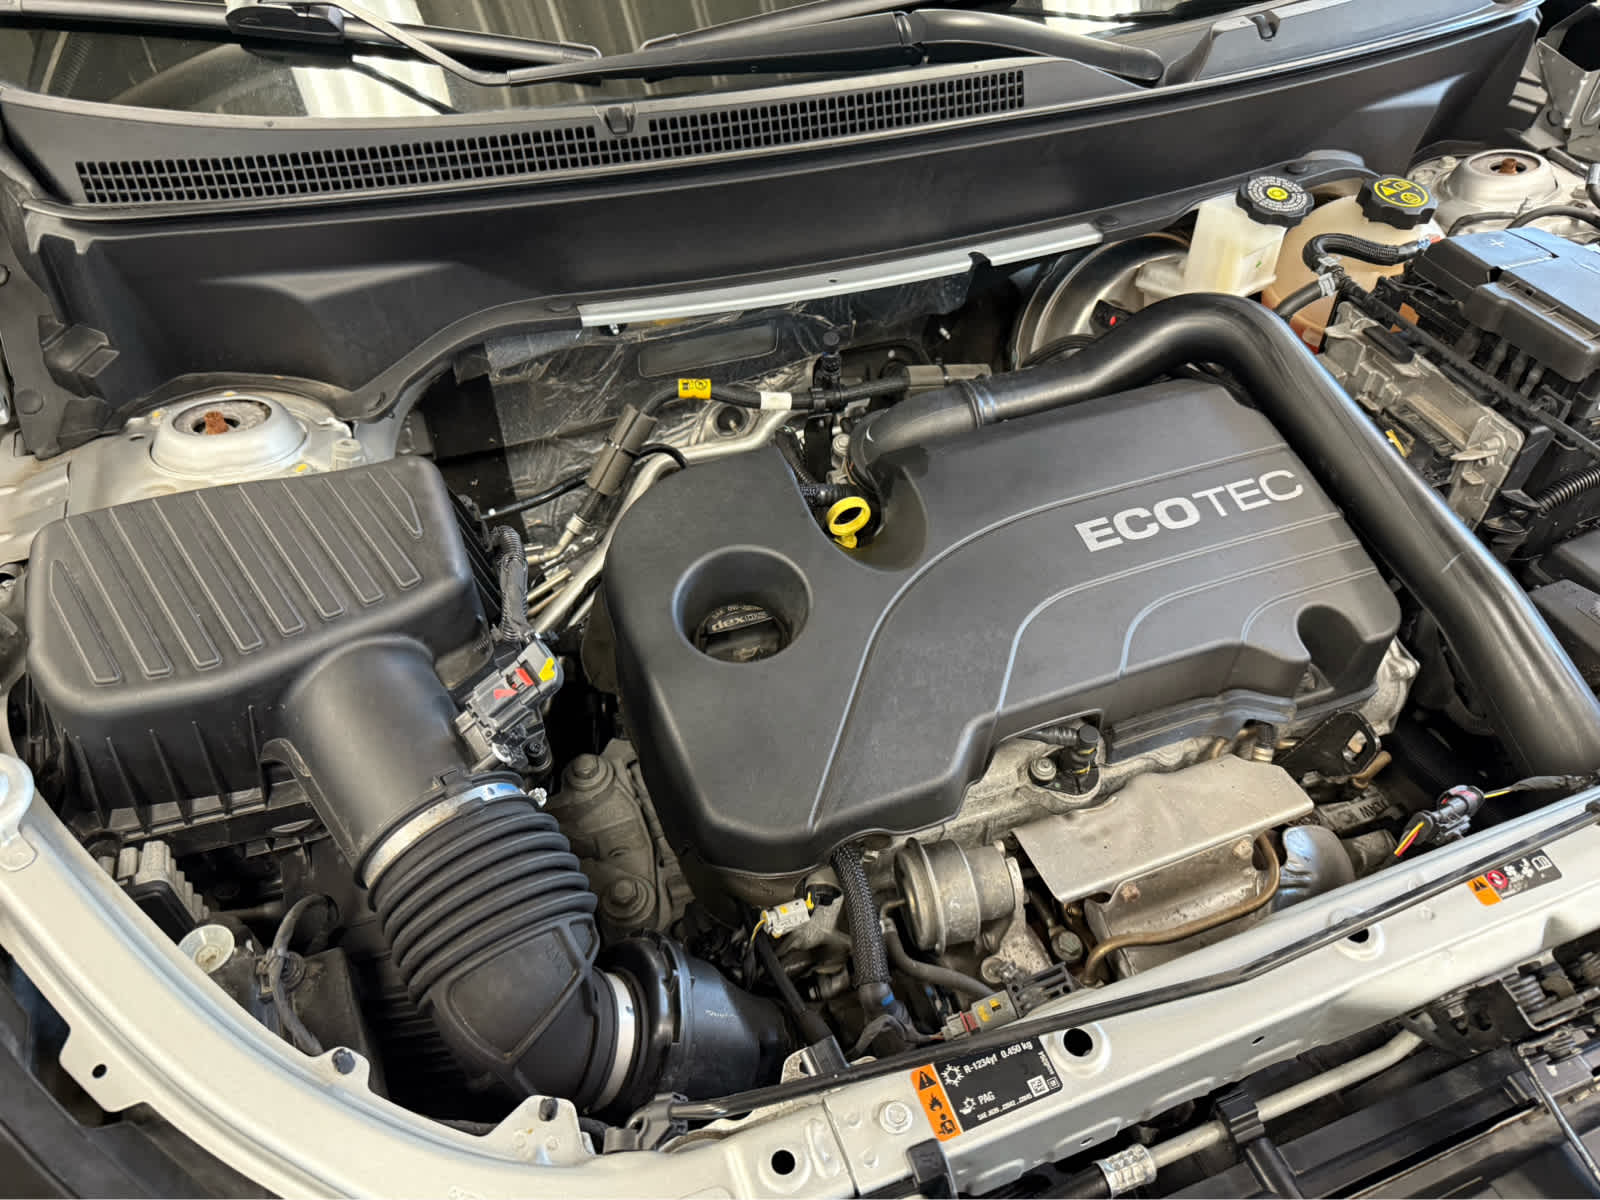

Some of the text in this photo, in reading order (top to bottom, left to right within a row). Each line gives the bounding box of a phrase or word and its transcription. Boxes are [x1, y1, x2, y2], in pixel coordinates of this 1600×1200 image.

[1074, 470, 1304, 552] ECOTEC
[1000, 1043, 1022, 1059] 0.450
[1021, 1041, 1033, 1051] kg
[977, 1091, 996, 1105] PAG
